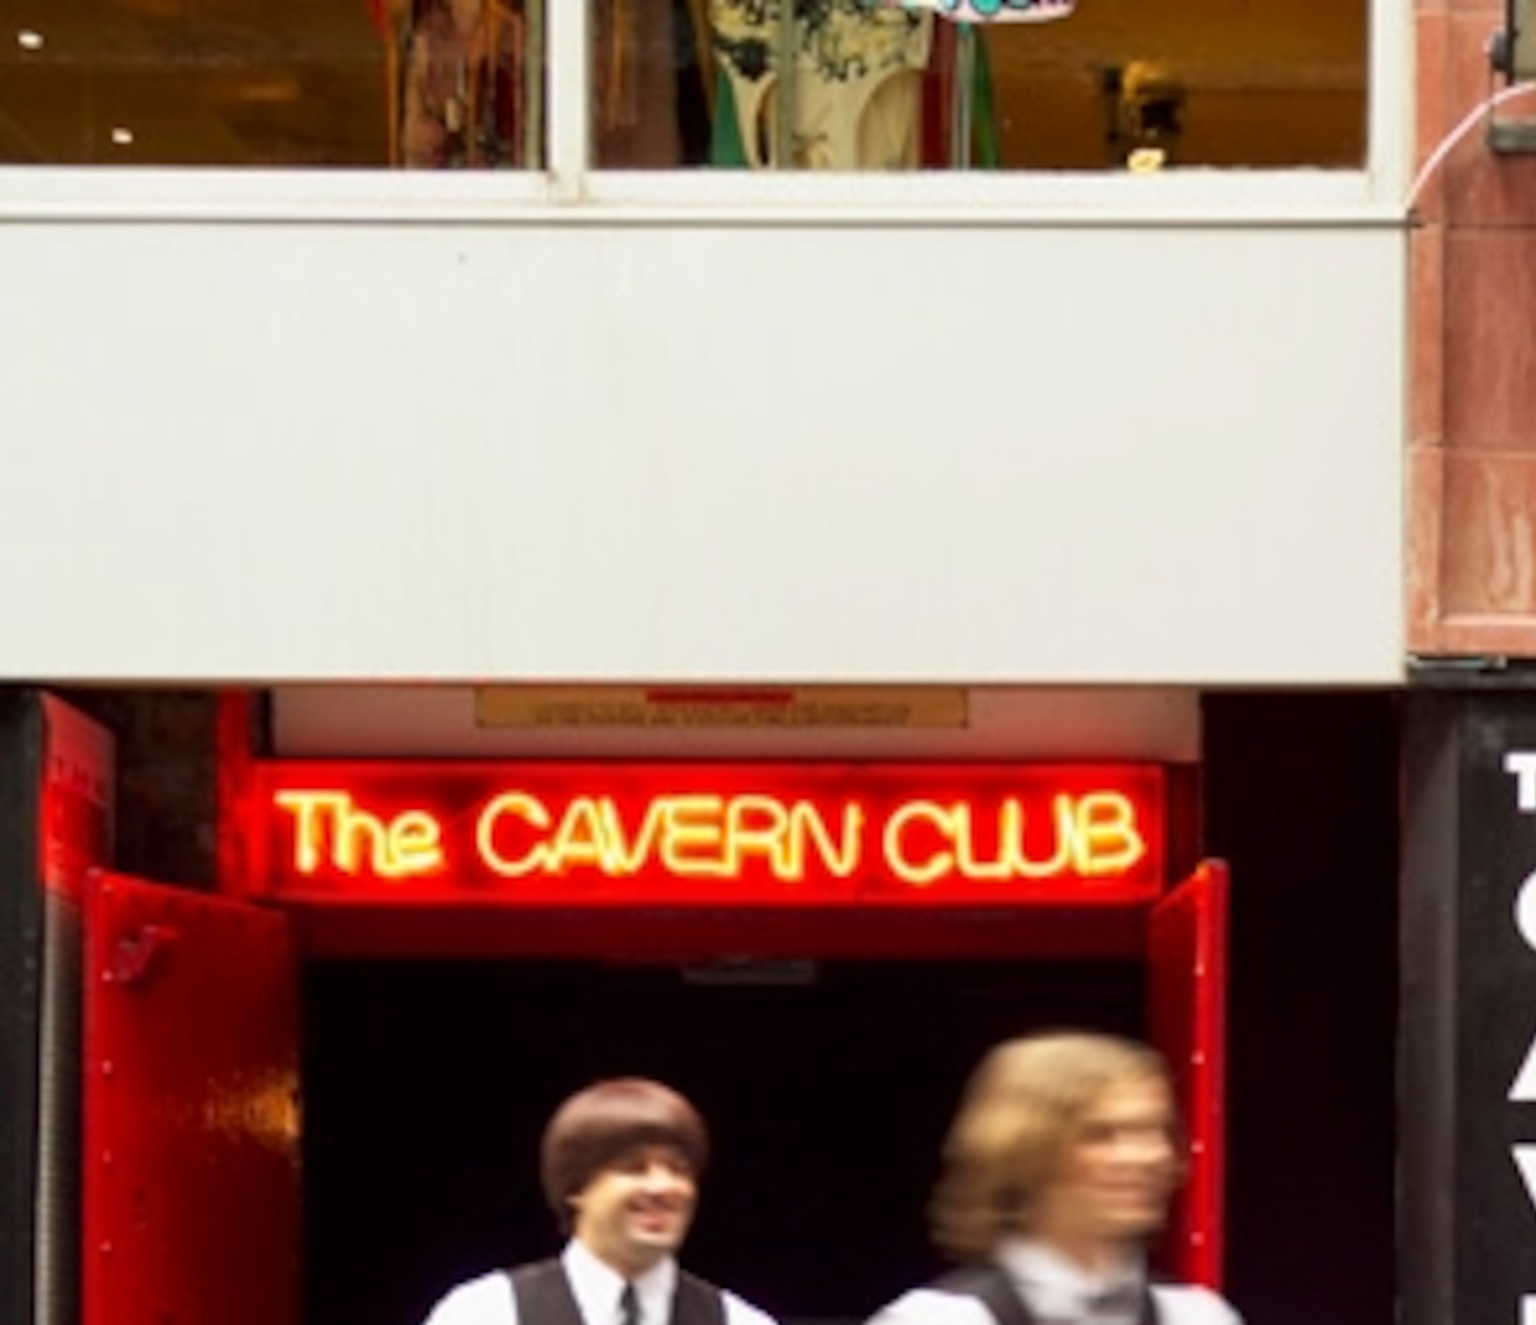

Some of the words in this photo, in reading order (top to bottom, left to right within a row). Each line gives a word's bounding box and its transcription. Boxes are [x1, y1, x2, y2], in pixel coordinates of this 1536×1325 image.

[274, 790, 443, 876] The
[476, 793, 861, 880] CAVERN
[882, 791, 1144, 882] CLUB
